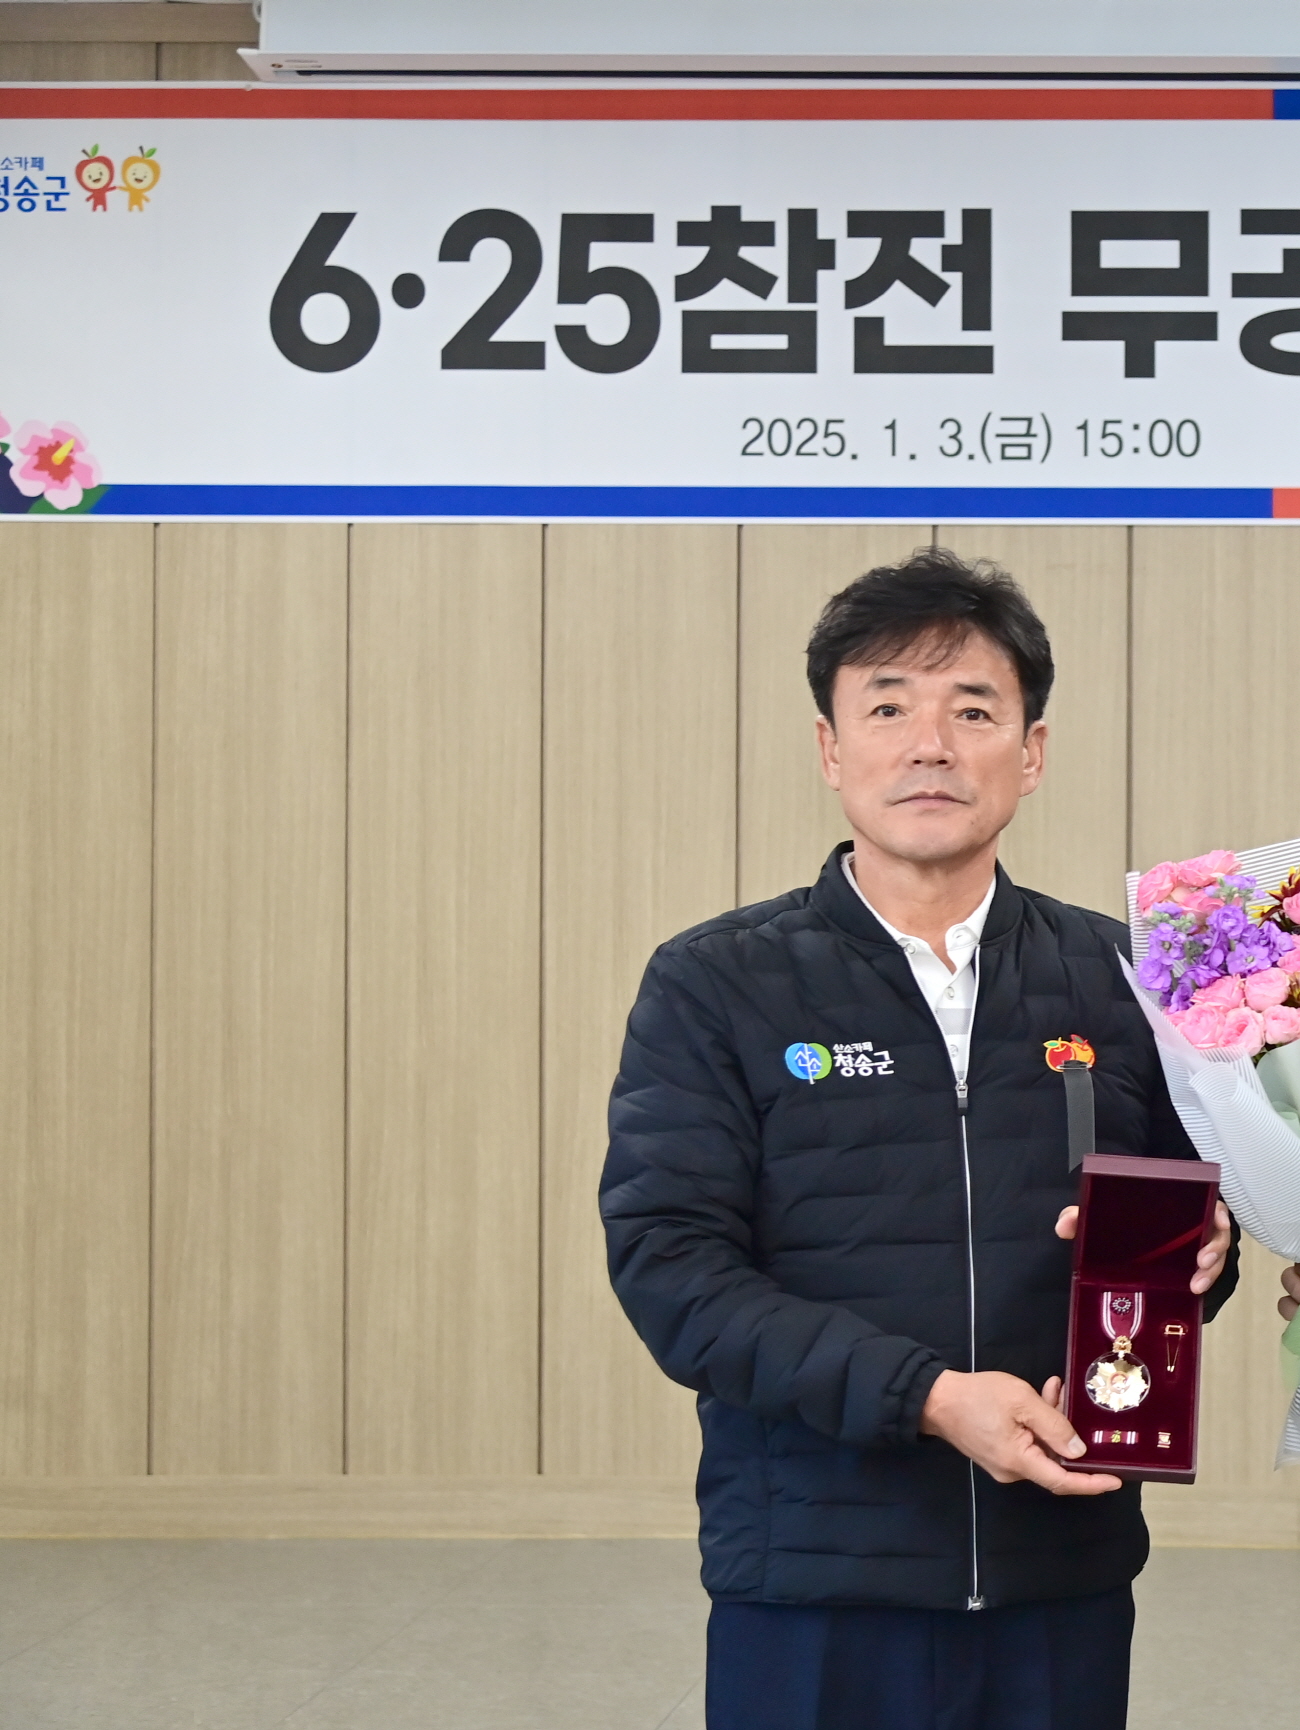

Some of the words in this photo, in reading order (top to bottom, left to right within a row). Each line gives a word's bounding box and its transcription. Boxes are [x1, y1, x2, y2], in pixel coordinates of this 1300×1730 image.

[0, 156, 45, 172] 소카페
[268, 204, 995, 375] 6·25참전
[740, 417, 859, 461] 2025.
[883, 418, 917, 461] 1.
[938, 411, 1053, 464] 3.(금)
[1075, 418, 1202, 458] 15:00
[832, 1041, 873, 1054] 산소카페
[832, 1050, 895, 1077] 청송군
